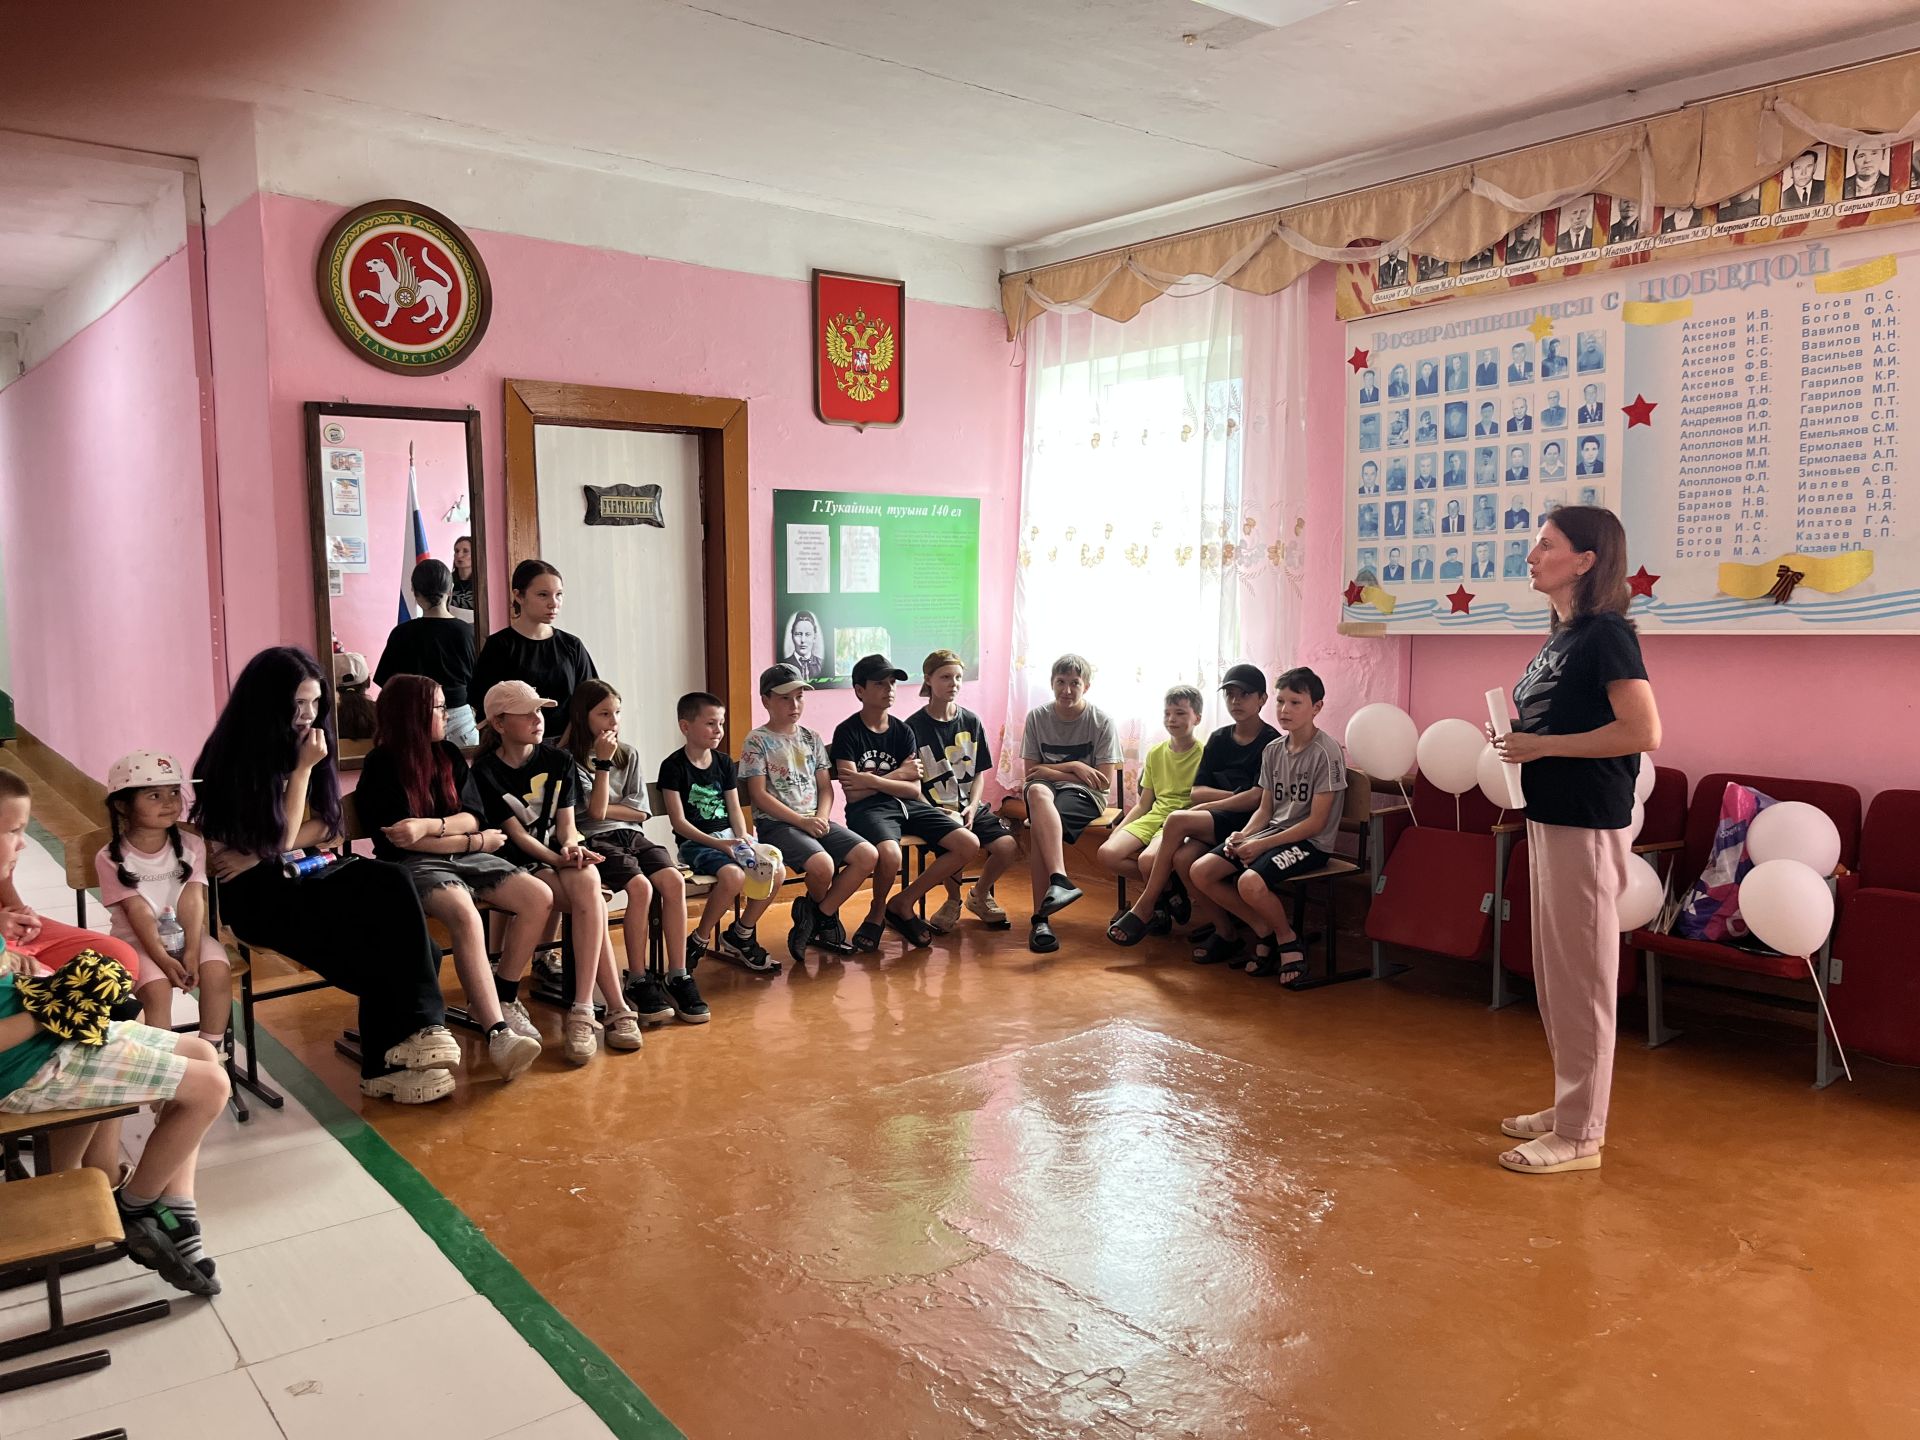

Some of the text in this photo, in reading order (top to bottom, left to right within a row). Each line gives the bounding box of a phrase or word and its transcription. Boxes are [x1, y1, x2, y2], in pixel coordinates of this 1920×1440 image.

[1838, 201, 1874, 214] Гаврилов
[1774, 211, 1811, 224] Филиппов
[1714, 222, 1749, 235] Миронов
[1601, 292, 1619, 310] С
[1638, 243, 1831, 302] ПОБЕДОЙ
[1802, 290, 1900, 312] Богов П.С.
[1683, 310, 1773, 331] Аксенов И.В.
[1802, 304, 1900, 324] Богов Ф.А.
[1682, 323, 1773, 343] Аксенов И.П.
[1802, 316, 1900, 338] Вавилов М.Н.
[1682, 336, 1773, 355] Аксенов Н.Е.
[1802, 330, 1900, 351] Вавилов Н.Н.
[362, 337, 447, 363] ТАТАРСТАН
[1682, 348, 1773, 367] Аксенов С.С.
[1801, 343, 1900, 363] Васильев А.С.
[1682, 360, 1773, 379] Аксенов Ф.В.
[1801, 356, 1900, 376] Васильев М.И.
[1681, 373, 1772, 391] Аксенов Ф.Е.
[1801, 370, 1899, 389] Гаврилов К.Р.
[1681, 385, 1772, 403] Аксенова Т.Н.
[1801, 382, 1899, 401] Гаврилов М.П.
[1681, 397, 1772, 415] Андреянов Д.Ф.
[1801, 396, 1899, 414] Гаврилов П.Т.
[1681, 410, 1771, 427] Андреянов П.Ф.
[1800, 409, 1899, 428] Данилов С.П.
[1680, 422, 1771, 440] Аполлонов И.П.
[1800, 423, 1899, 439] Емельянов С.М.
[1680, 435, 1771, 452] Аполлонов М.Н.
[1800, 436, 1899, 453] Ермолаев Н.Т.
[1680, 447, 1770, 463] Аполлонов М.П.
[1799, 449, 1898, 465] Ермолаева А.П.
[1679, 460, 1770, 475] Аполлонов П.М.
[1799, 462, 1897, 477] Зиновьев С.П.
[1679, 472, 1770, 487] Аполлонов Ф.П.
[1799, 475, 1897, 490] Ивлев А.В.
[1679, 485, 1769, 500] Баранов Н.А.
[1798, 489, 1896, 503] Иовлев В.Д.
[887, 504, 928, 516] тууына
[931, 504, 949, 517] 140
[950, 507, 962, 517] ел
[1679, 497, 1768, 512] Баранов Н.В.
[1798, 502, 1896, 516] Иовлева Н.Я.
[1678, 509, 1768, 524] Баранов П.М.
[1797, 515, 1896, 528] Ипатов Г.А.
[1677, 523, 1767, 535] Богов И.С.
[1796, 528, 1896, 541] Казаев В.П.
[1677, 535, 1767, 547] Богов Л.А.
[1796, 542, 1864, 553] Казаев Н.П.
[1676, 547, 1767, 558] Богов М.А.
